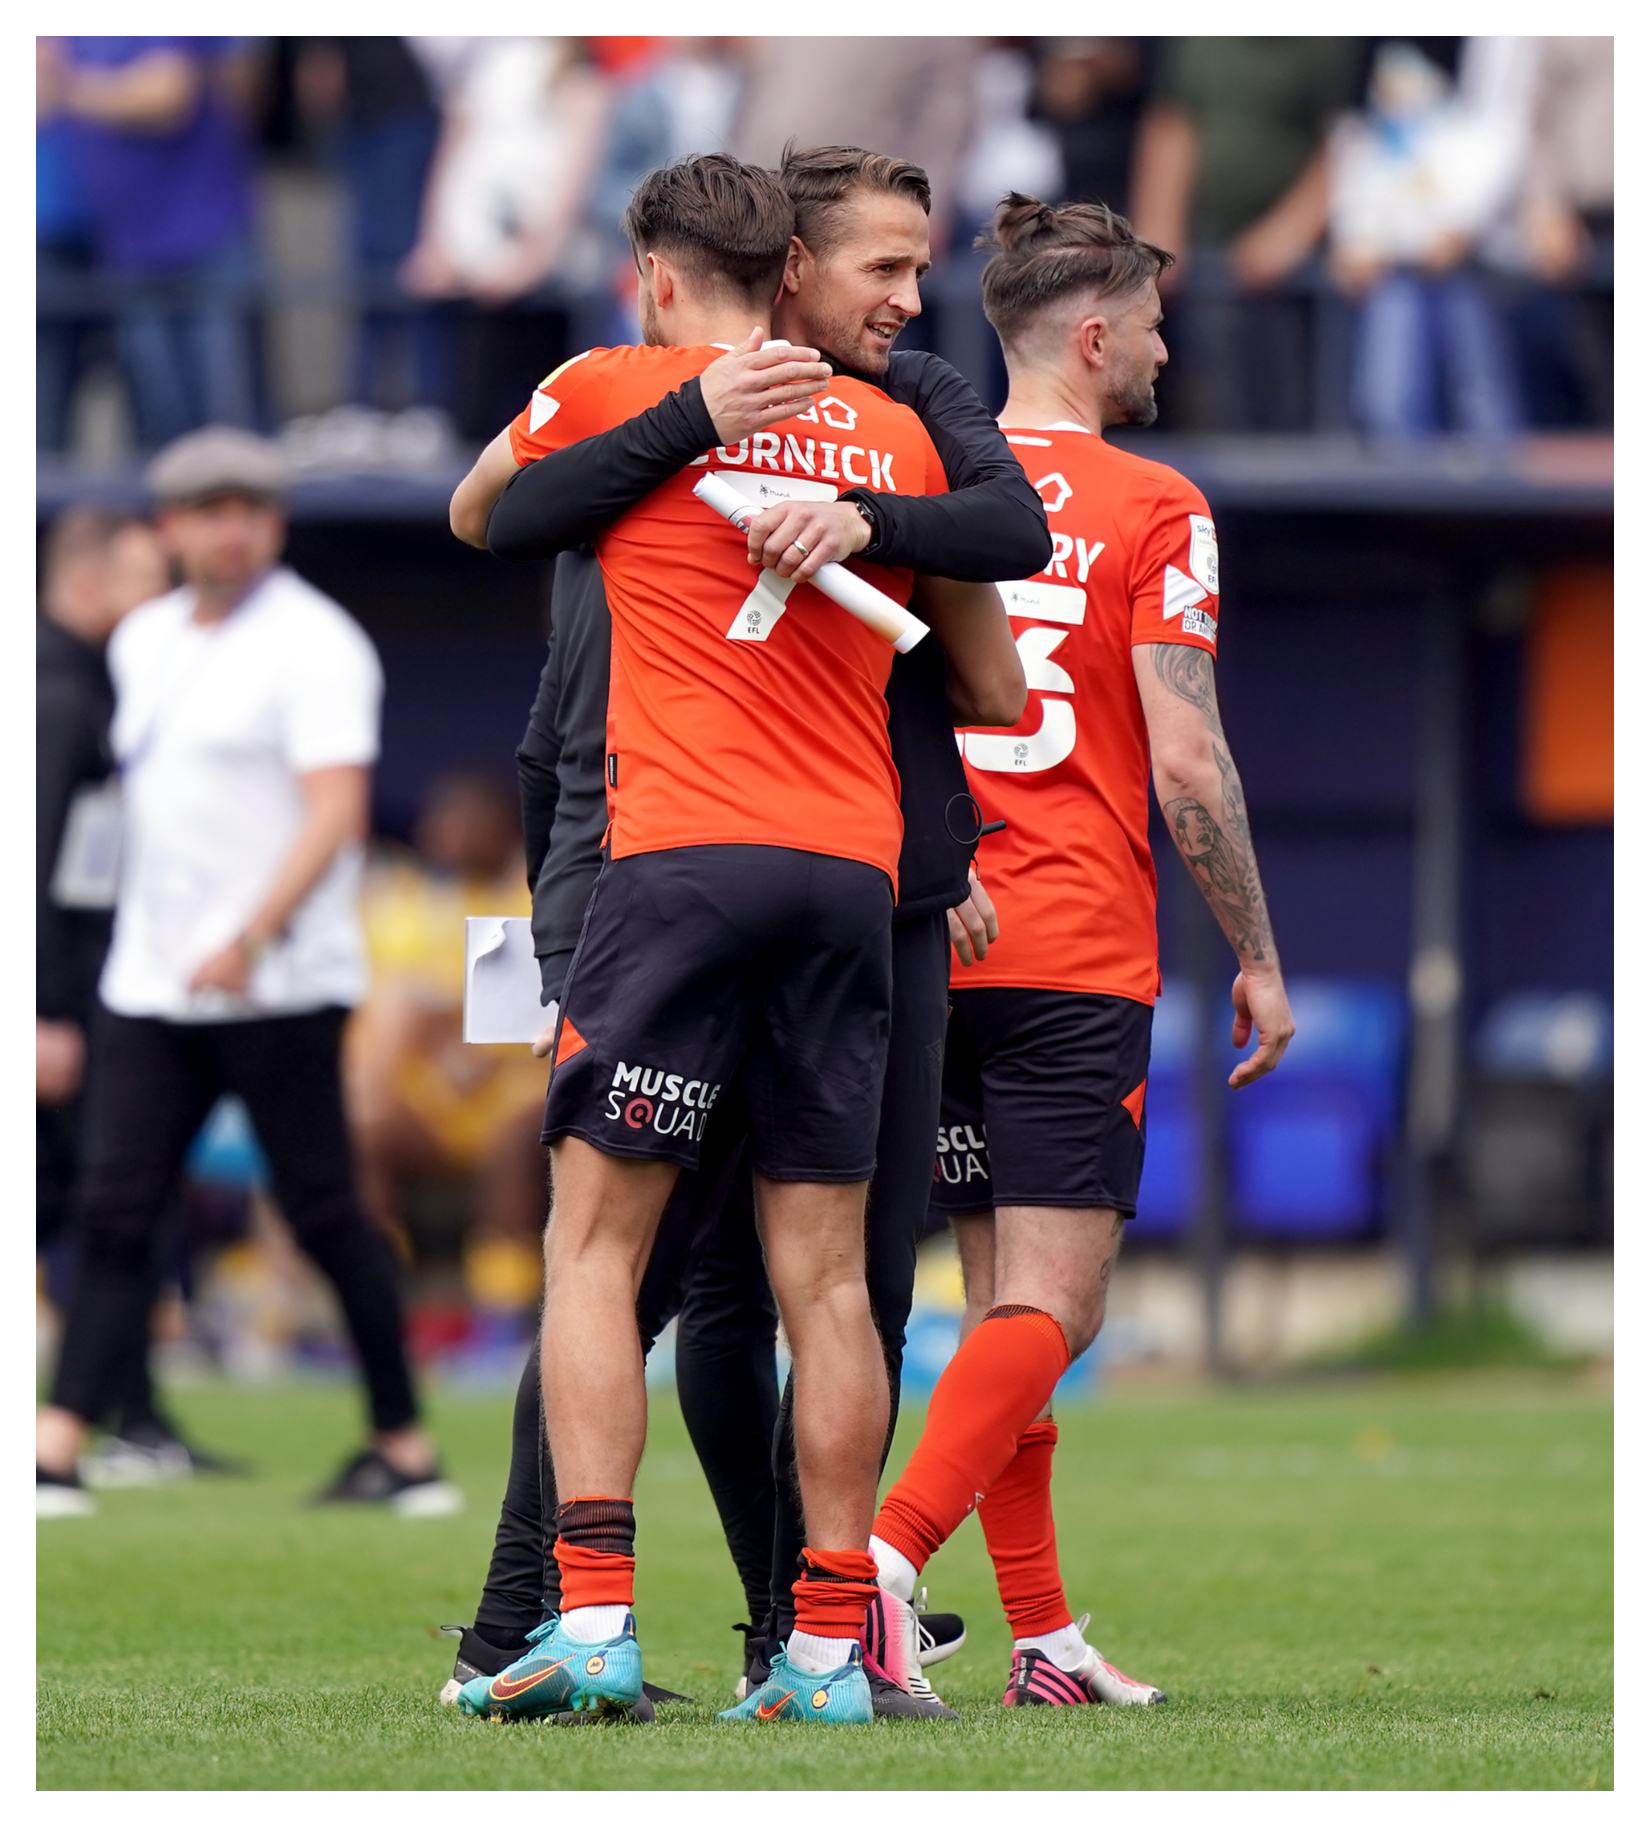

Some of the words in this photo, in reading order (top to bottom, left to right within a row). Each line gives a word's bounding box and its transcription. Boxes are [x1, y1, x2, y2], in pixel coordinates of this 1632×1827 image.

[689, 431, 897, 492] ORNICK
[1196, 524, 1211, 538] sky
[1043, 532, 1106, 583] RY
[1184, 606, 1203, 621] NOT
[1184, 619, 1197, 632] OR
[747, 626, 760, 635] EFL
[954, 580, 1088, 774] 3
[1014, 759, 1027, 767] EFL
[611, 1061, 722, 1109] MUSCLE
[936, 1123, 988, 1153] SCL
[934, 1150, 990, 1184] UA
